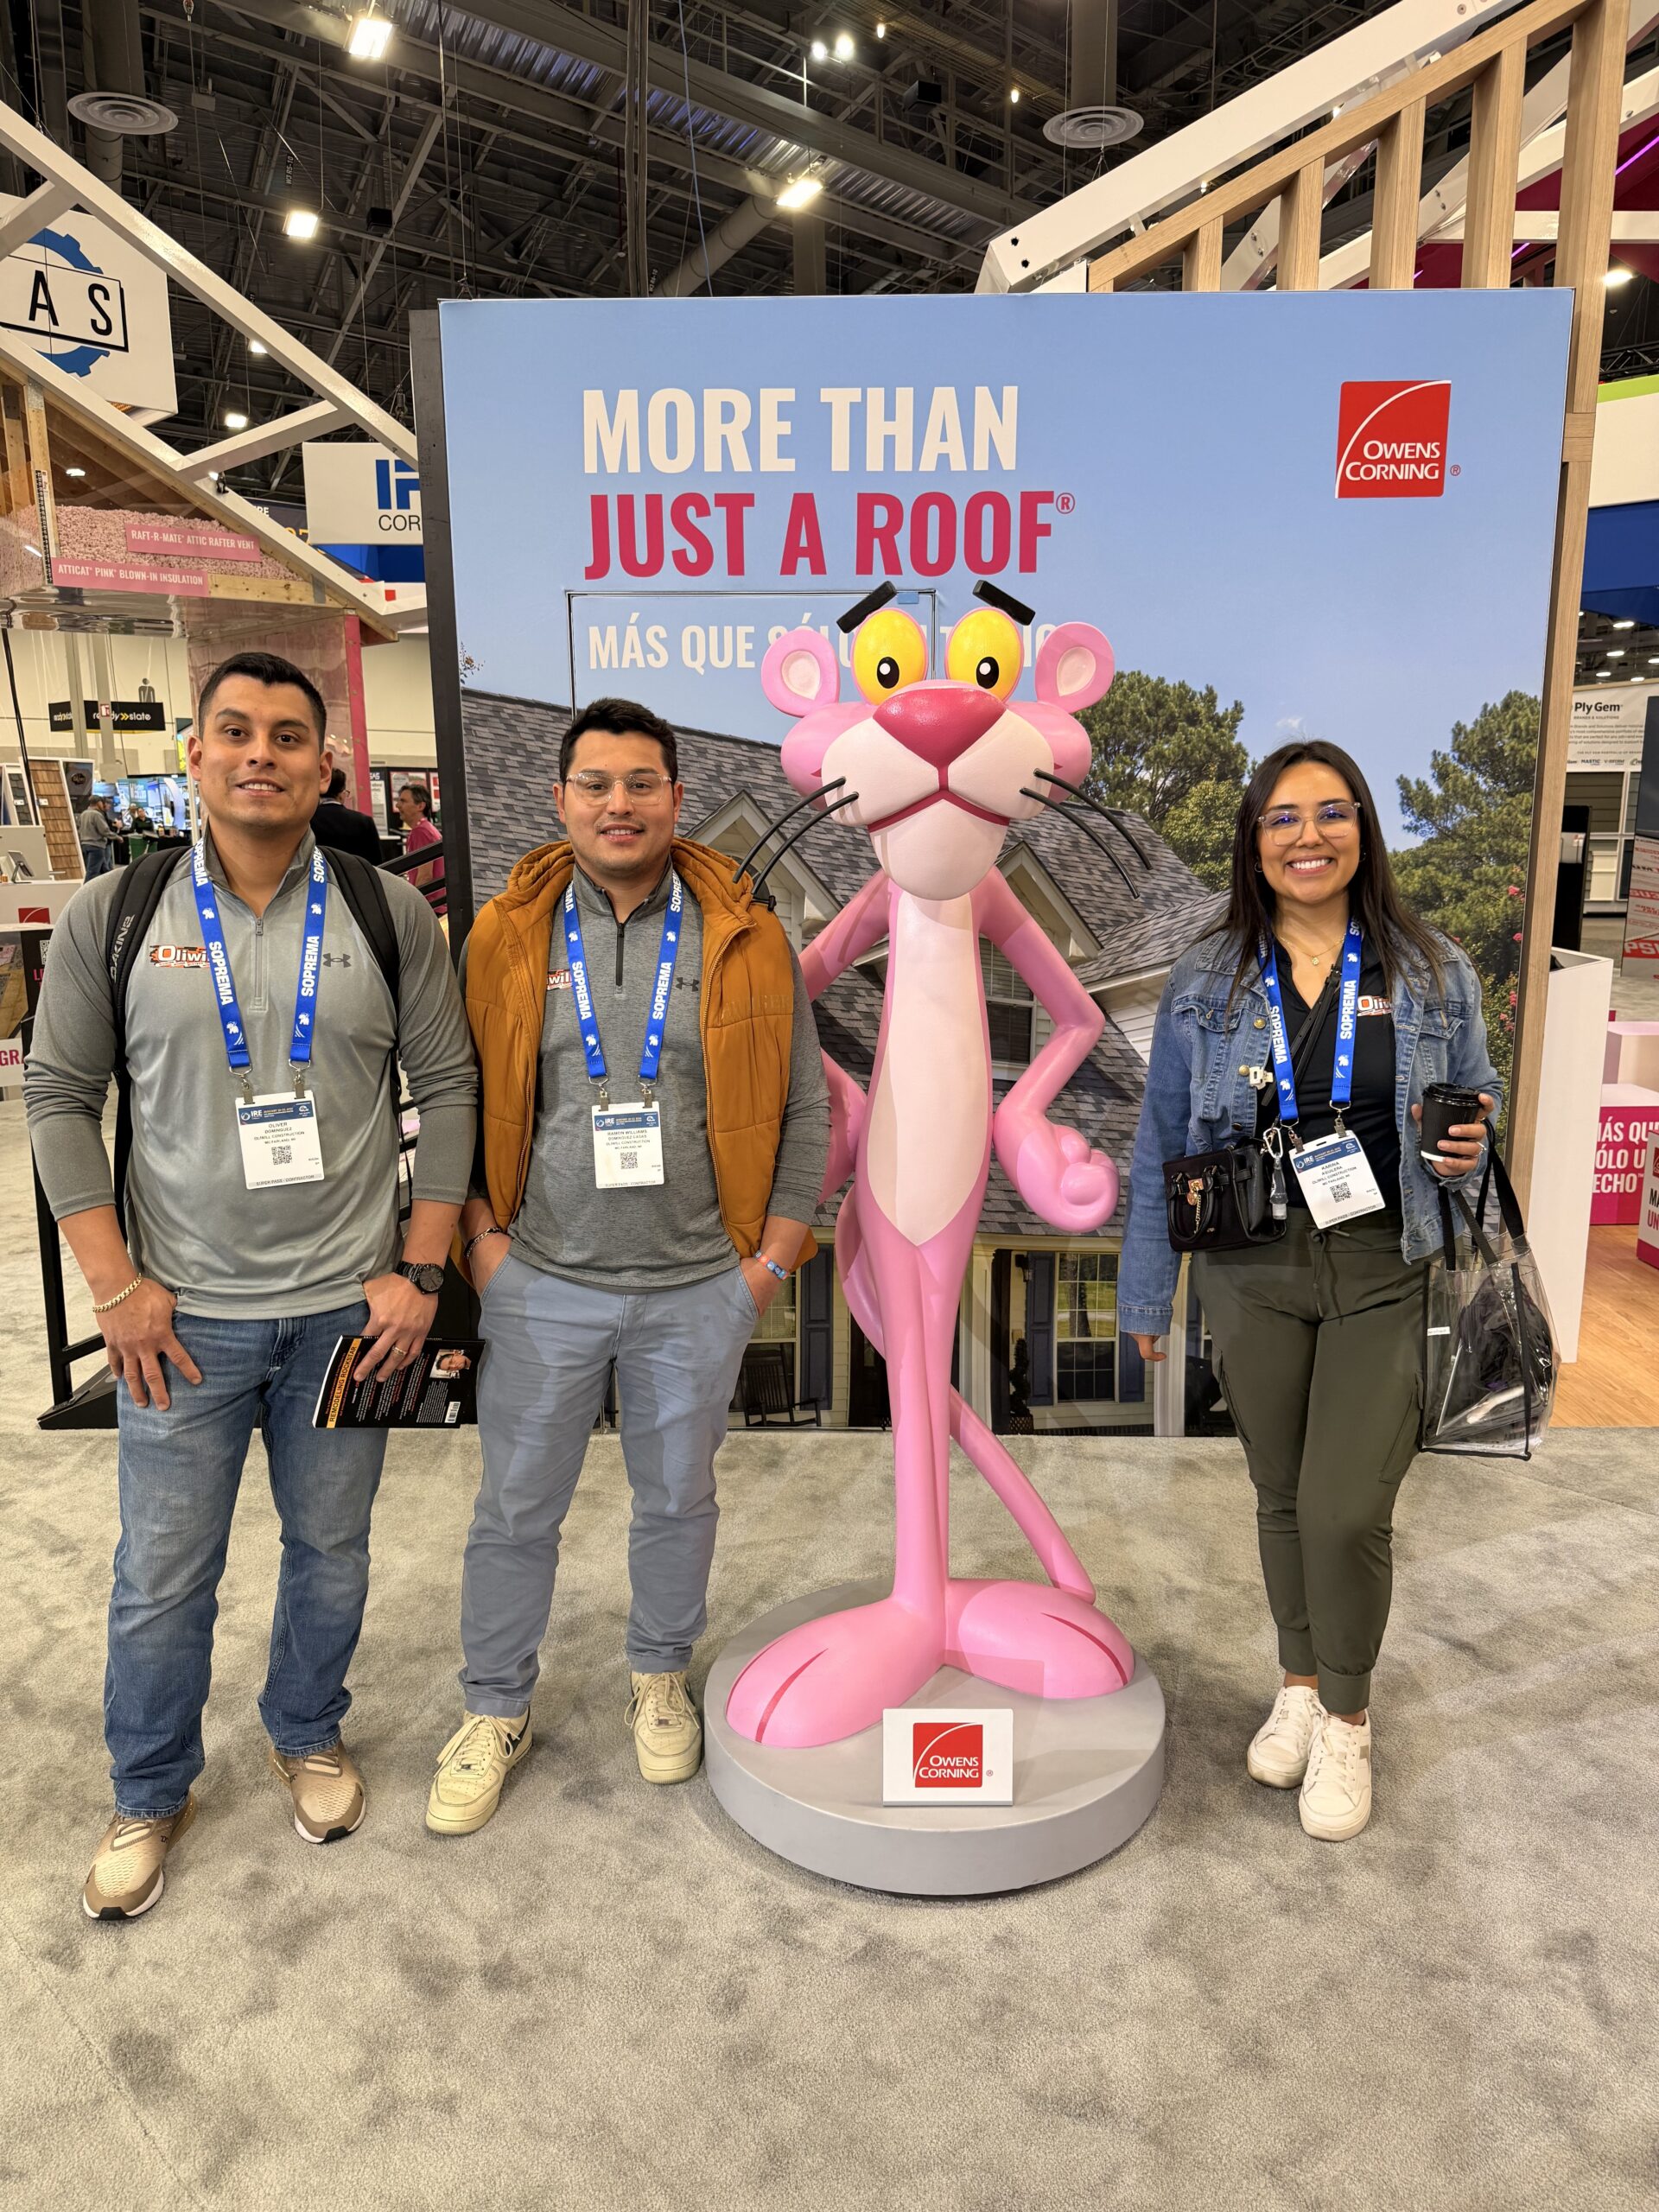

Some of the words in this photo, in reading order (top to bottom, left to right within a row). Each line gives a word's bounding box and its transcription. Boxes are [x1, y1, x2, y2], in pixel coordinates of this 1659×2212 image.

[583, 388, 796, 474] MORE
[820, 385, 1019, 472] THAN
[1363, 440, 1440, 460] OWENS
[1345, 461, 1439, 481] CORNING
[187, 535, 207, 546] ATTIC
[209, 537, 236, 548] RAFTER
[237, 540, 254, 550] VENT
[585, 492, 755, 580] JUST
[779, 492, 827, 575] A
[119, 569, 158, 582] BLOWN-IN
[160, 574, 203, 585] INSULATION
[588, 613, 669, 670] MÁS
[681, 625, 756, 677] QUE
[1574, 702, 1593, 715] Ply
[1594, 702, 1620, 712] Gem
[209, 941, 234, 1006] SOPREMA
[302, 936, 320, 997] SOPREMA
[571, 960, 592, 1020] SOPREMA
[652, 962, 672, 1020] SOPREMA
[1269, 1005, 1287, 1065] SOPREMA
[1340, 980, 1357, 1039] SOPREMA
[329, 1376, 345, 1422] REMODELING
[341, 1346, 357, 1377] ROCKSTAR
[918, 1767, 979, 1779] CORNING
[930, 1755, 979, 1767] OWENS
